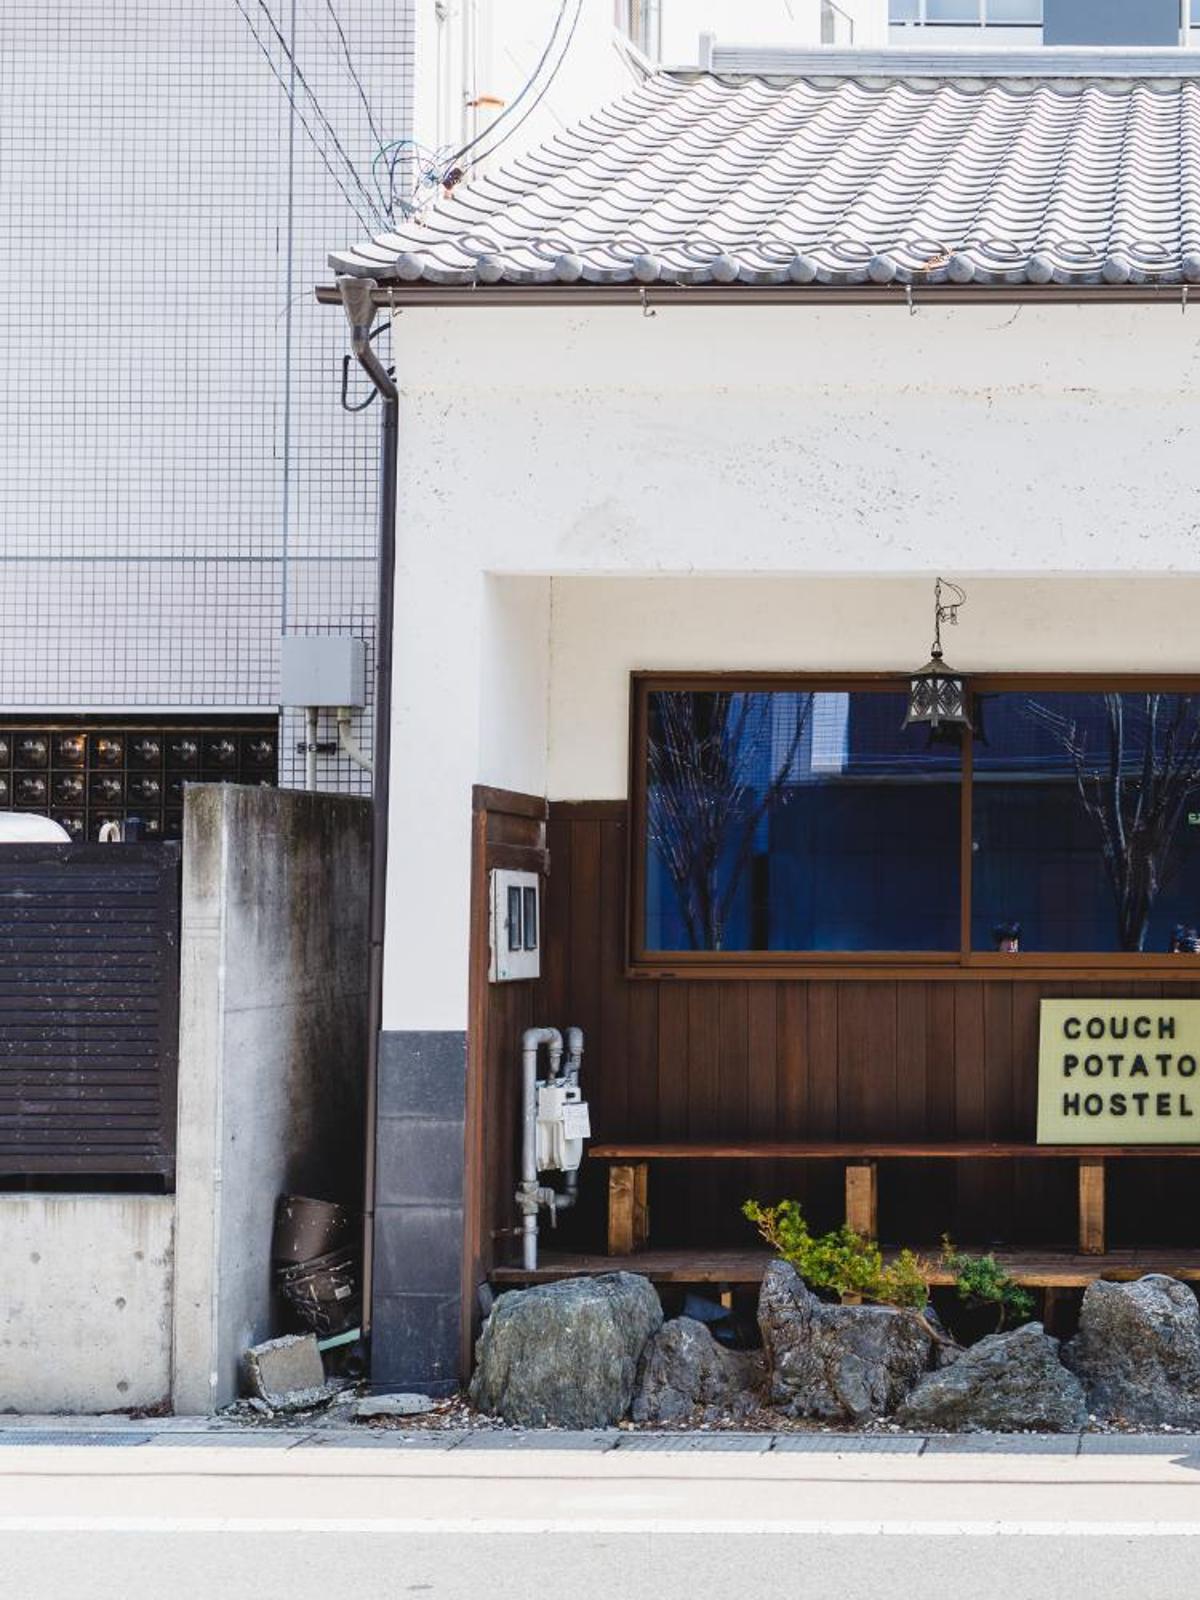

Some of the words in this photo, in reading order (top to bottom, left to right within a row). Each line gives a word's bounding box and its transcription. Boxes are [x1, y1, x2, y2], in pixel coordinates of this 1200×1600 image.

[1062, 1015, 1176, 1040] COUCH
[1062, 1053, 1198, 1078] POTATO
[1062, 1092, 1194, 1117] HOSTEL
